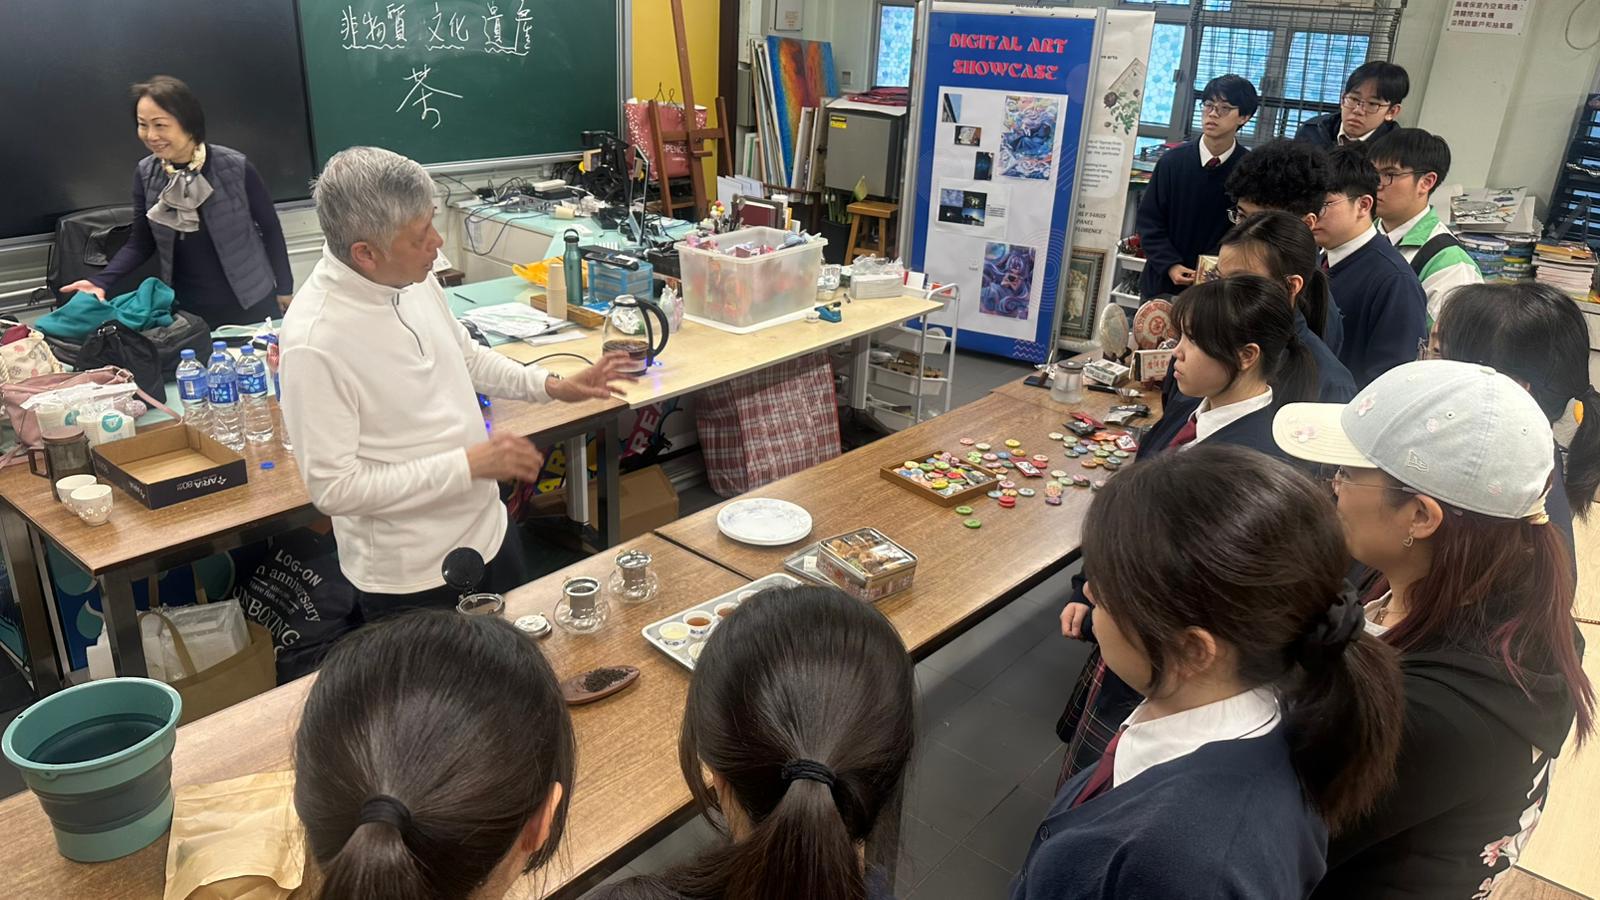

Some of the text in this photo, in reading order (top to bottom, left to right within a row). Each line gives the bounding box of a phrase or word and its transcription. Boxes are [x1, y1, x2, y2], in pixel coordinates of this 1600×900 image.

[949, 32, 1068, 54] DIGITAL ART
[952, 59, 1059, 81] SHOWCASE
[396, 64, 463, 129] 茶
[275, 549, 322, 587] LOG-ON
[269, 568, 321, 622] anniversary
